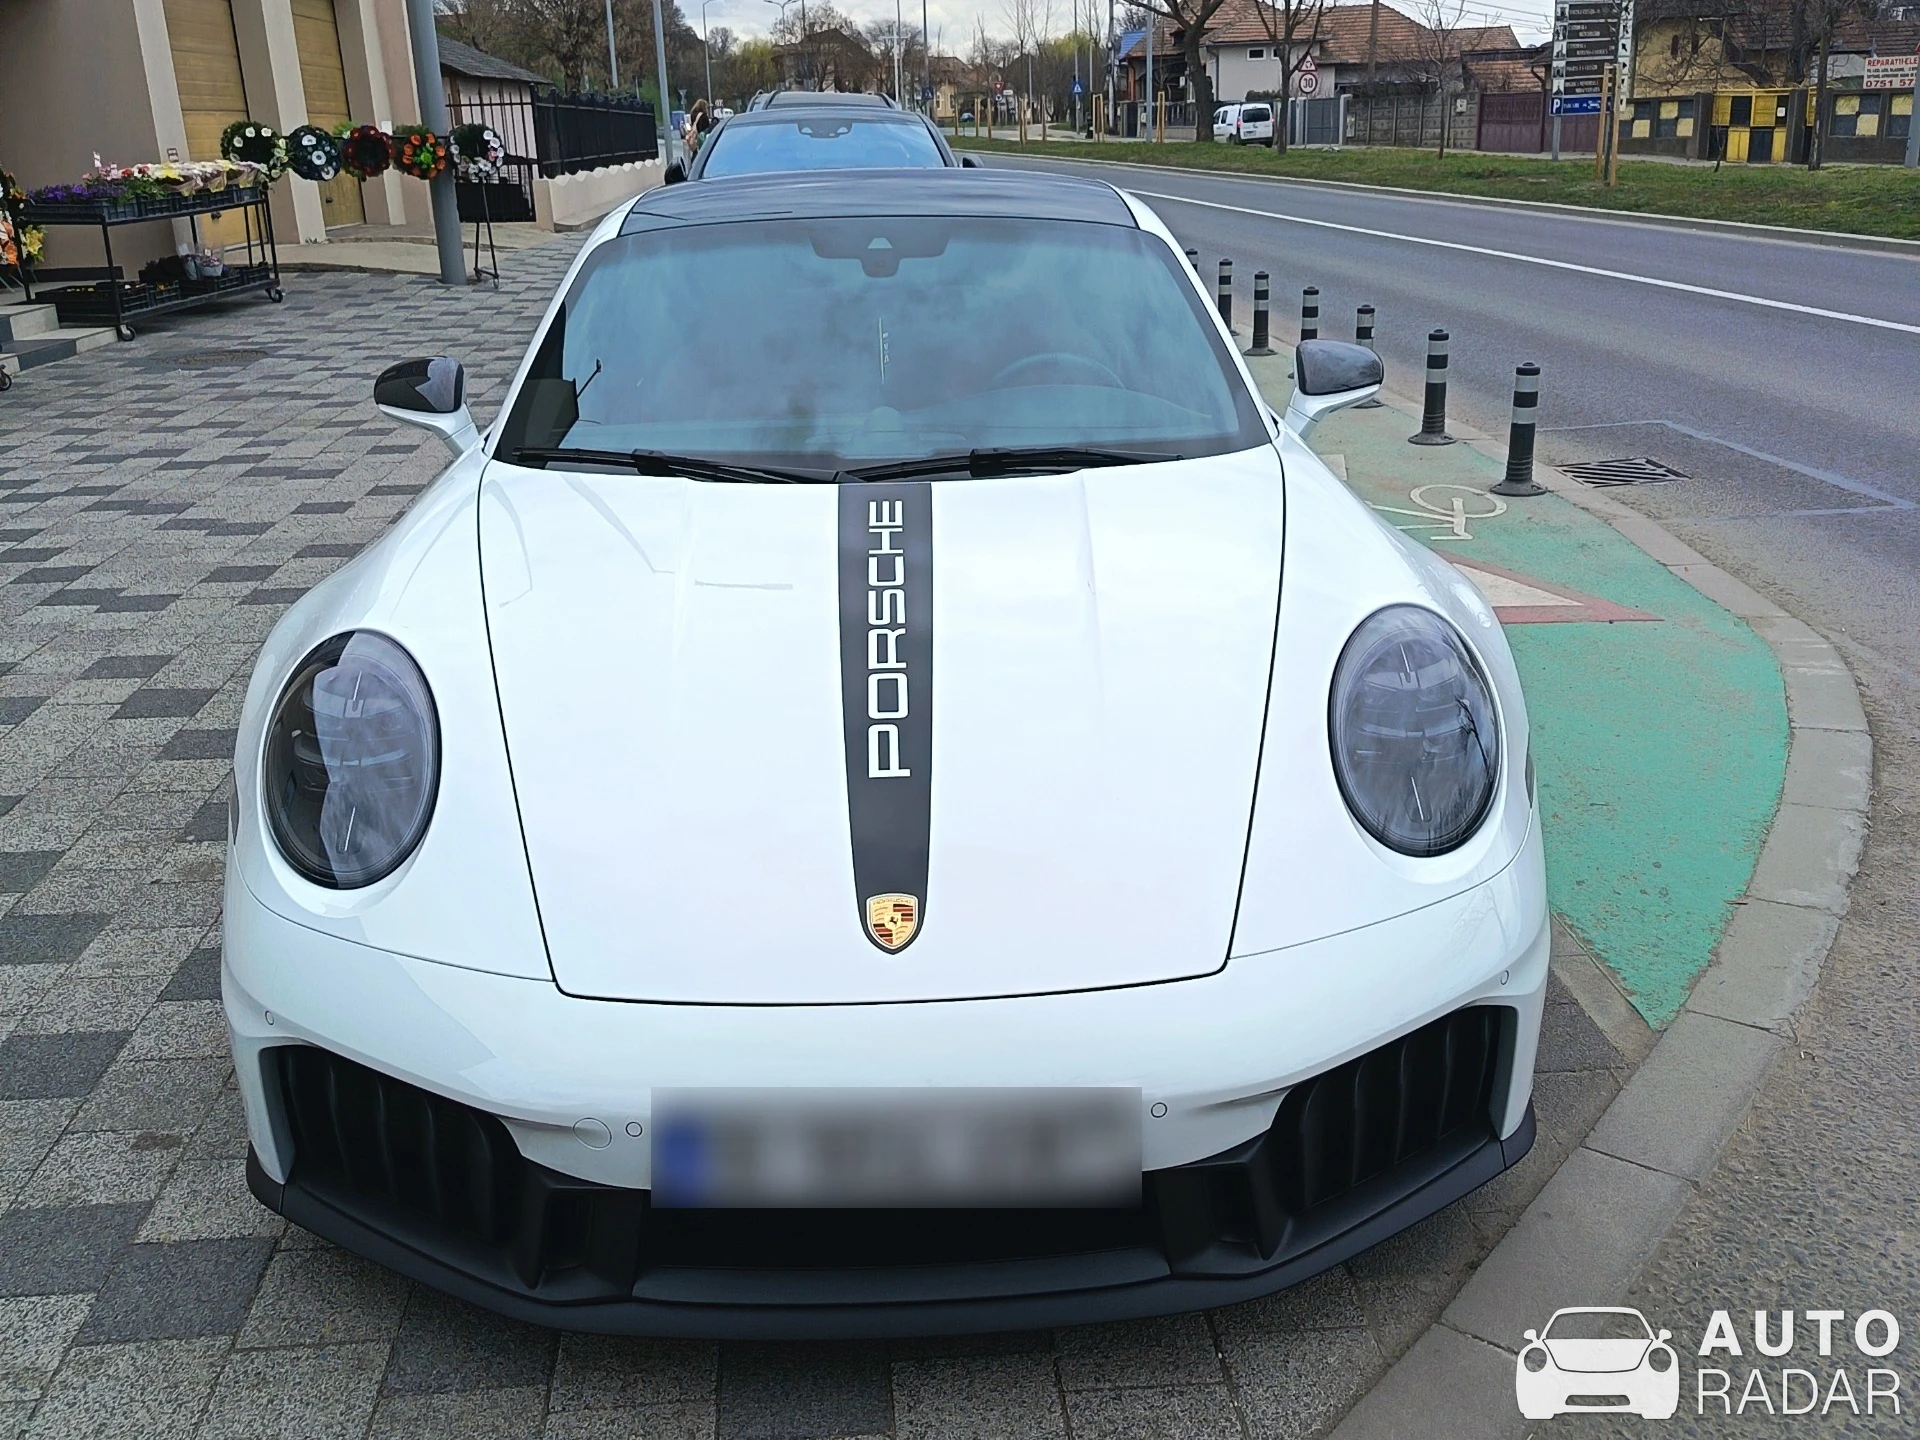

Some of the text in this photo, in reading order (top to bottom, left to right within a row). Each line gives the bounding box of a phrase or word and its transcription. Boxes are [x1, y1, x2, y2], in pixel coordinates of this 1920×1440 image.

[1303, 77, 1313, 88] 30
[1865, 80, 1894, 88] 0751
[1553, 98, 1561, 114] P
[867, 499, 911, 779] PORSCHE
